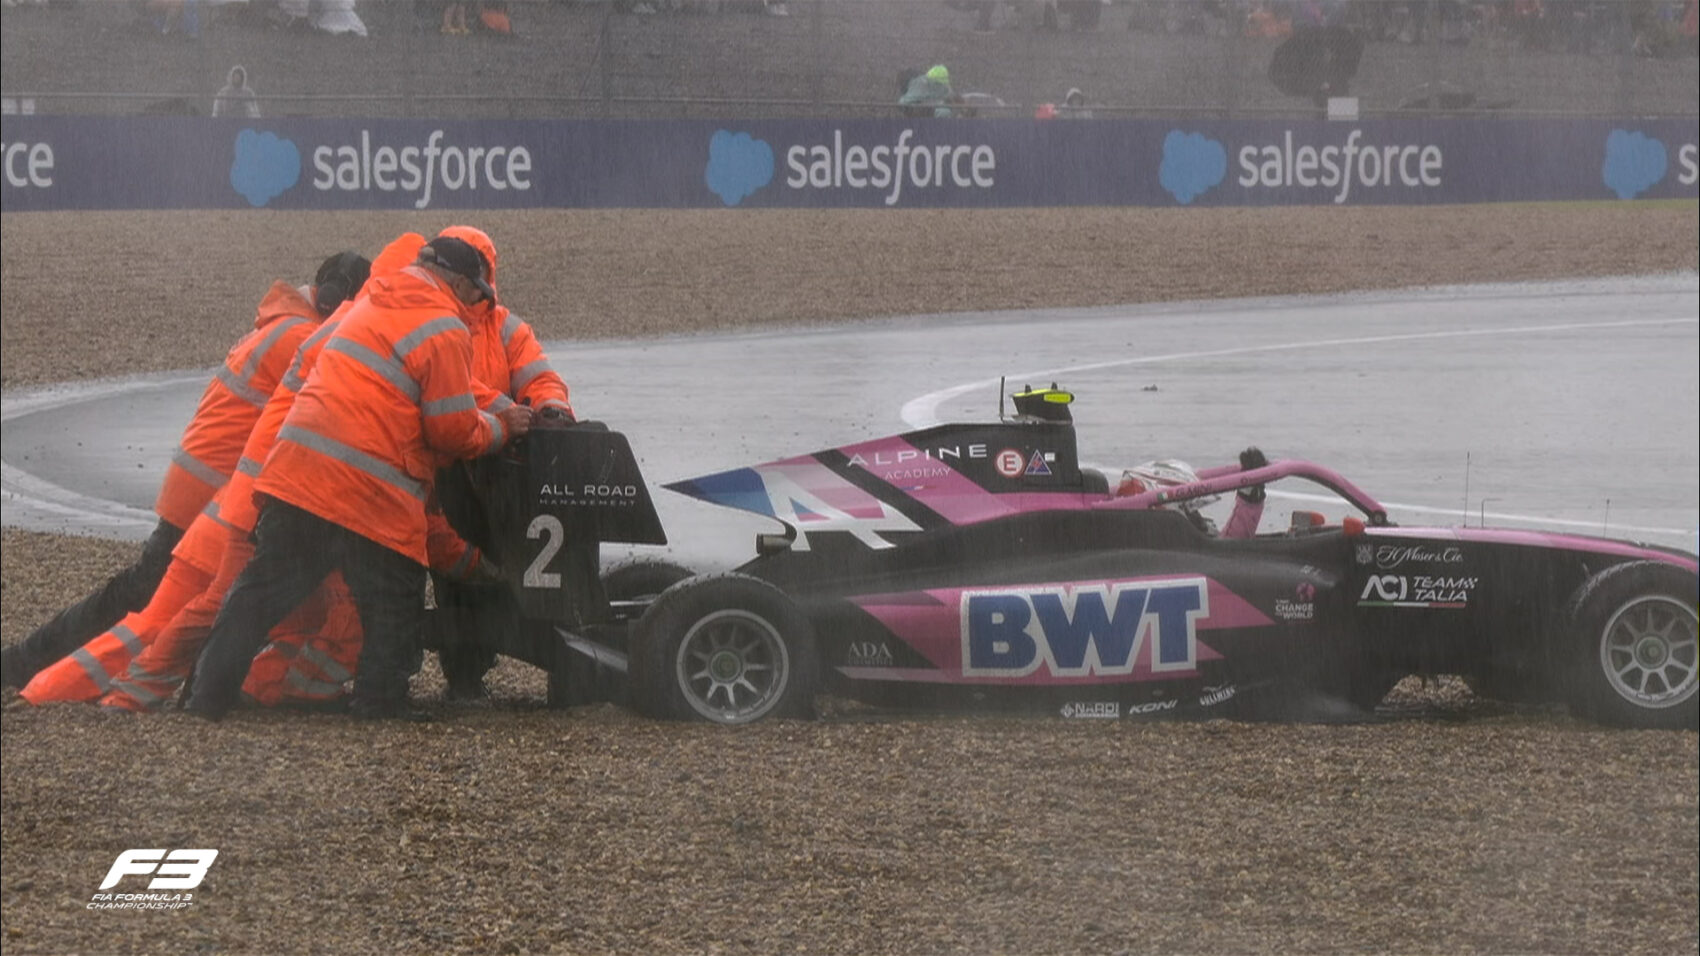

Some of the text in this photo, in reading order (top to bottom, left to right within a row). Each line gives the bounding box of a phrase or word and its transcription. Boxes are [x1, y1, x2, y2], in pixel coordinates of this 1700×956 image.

[1, 142, 54, 188] ce
[313, 129, 532, 208] salesforce
[786, 129, 996, 205] salesforce
[1238, 129, 1443, 204] salesforce
[847, 444, 988, 467] ALPINE
[884, 466, 951, 480] ACADEMY
[540, 484, 637, 497] ALL ROAD
[523, 514, 564, 588] 2
[1361, 575, 1407, 600] ACI
[1414, 576, 1464, 588] TEAM
[1275, 603, 1313, 612] CHANGE
[960, 576, 1210, 678] BWT
[848, 641, 893, 657] ADA
[1129, 699, 1177, 715] KONI
